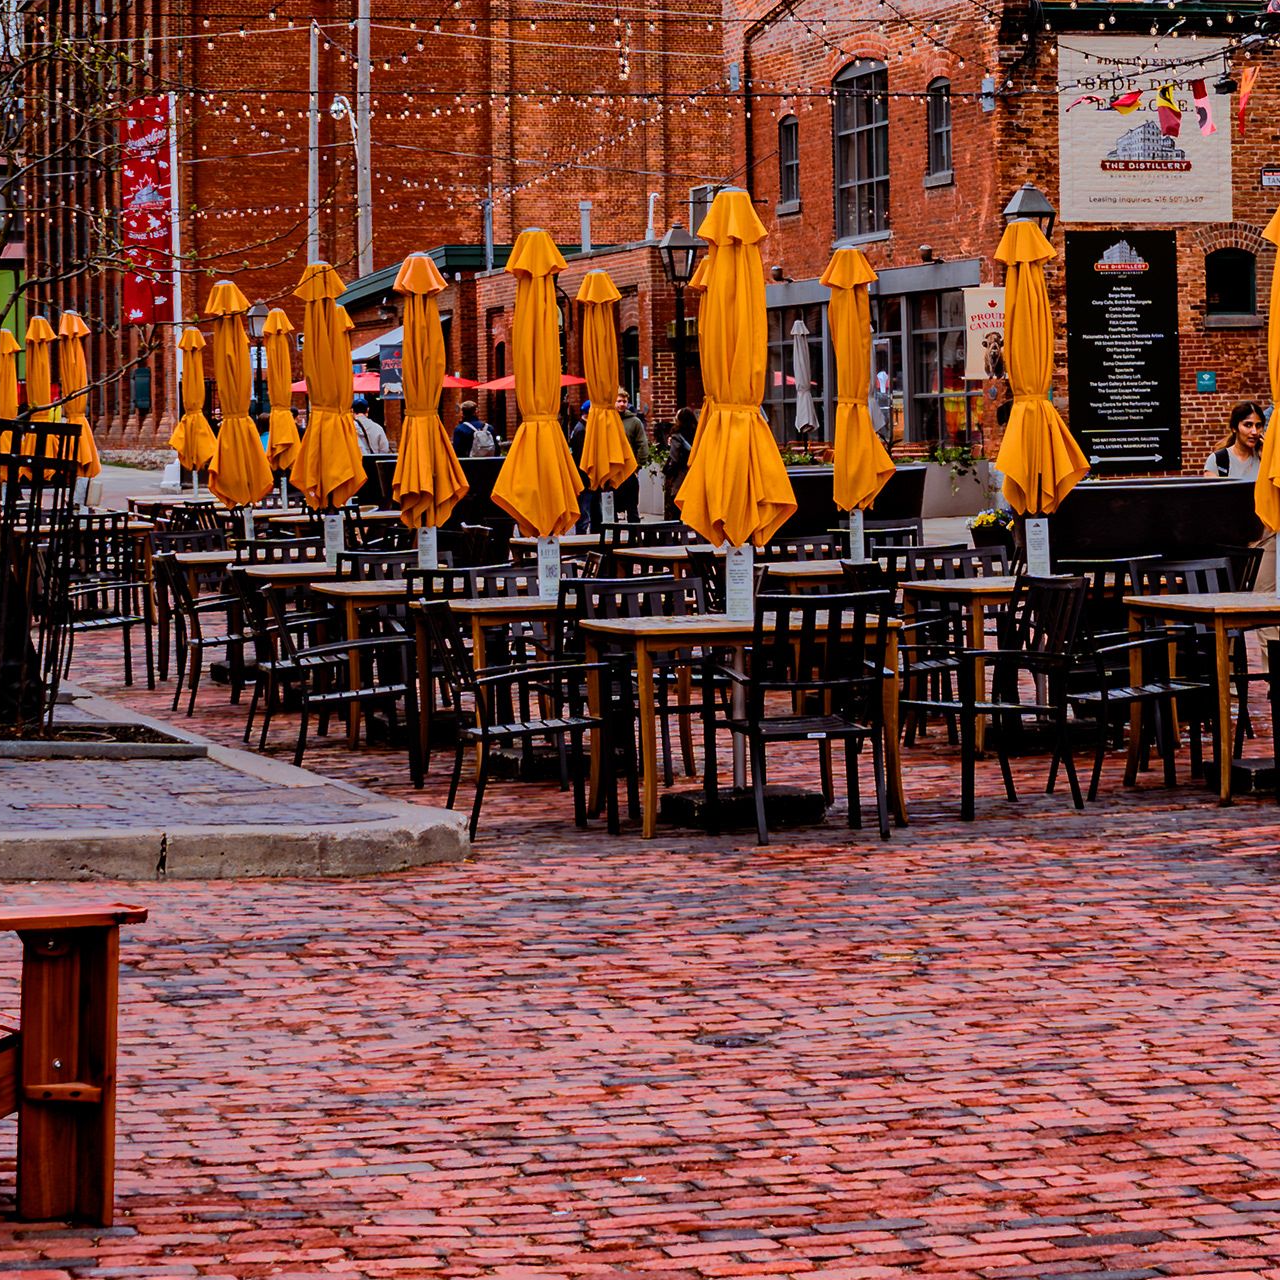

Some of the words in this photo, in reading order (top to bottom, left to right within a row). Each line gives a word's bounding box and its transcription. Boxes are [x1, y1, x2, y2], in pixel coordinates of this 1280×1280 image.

[1128, 162, 1188, 170] DISTILLERY
[1088, 195, 1118, 204] Leasing
[970, 312, 1005, 322] PROUD
[969, 321, 1005, 331] CANADI
